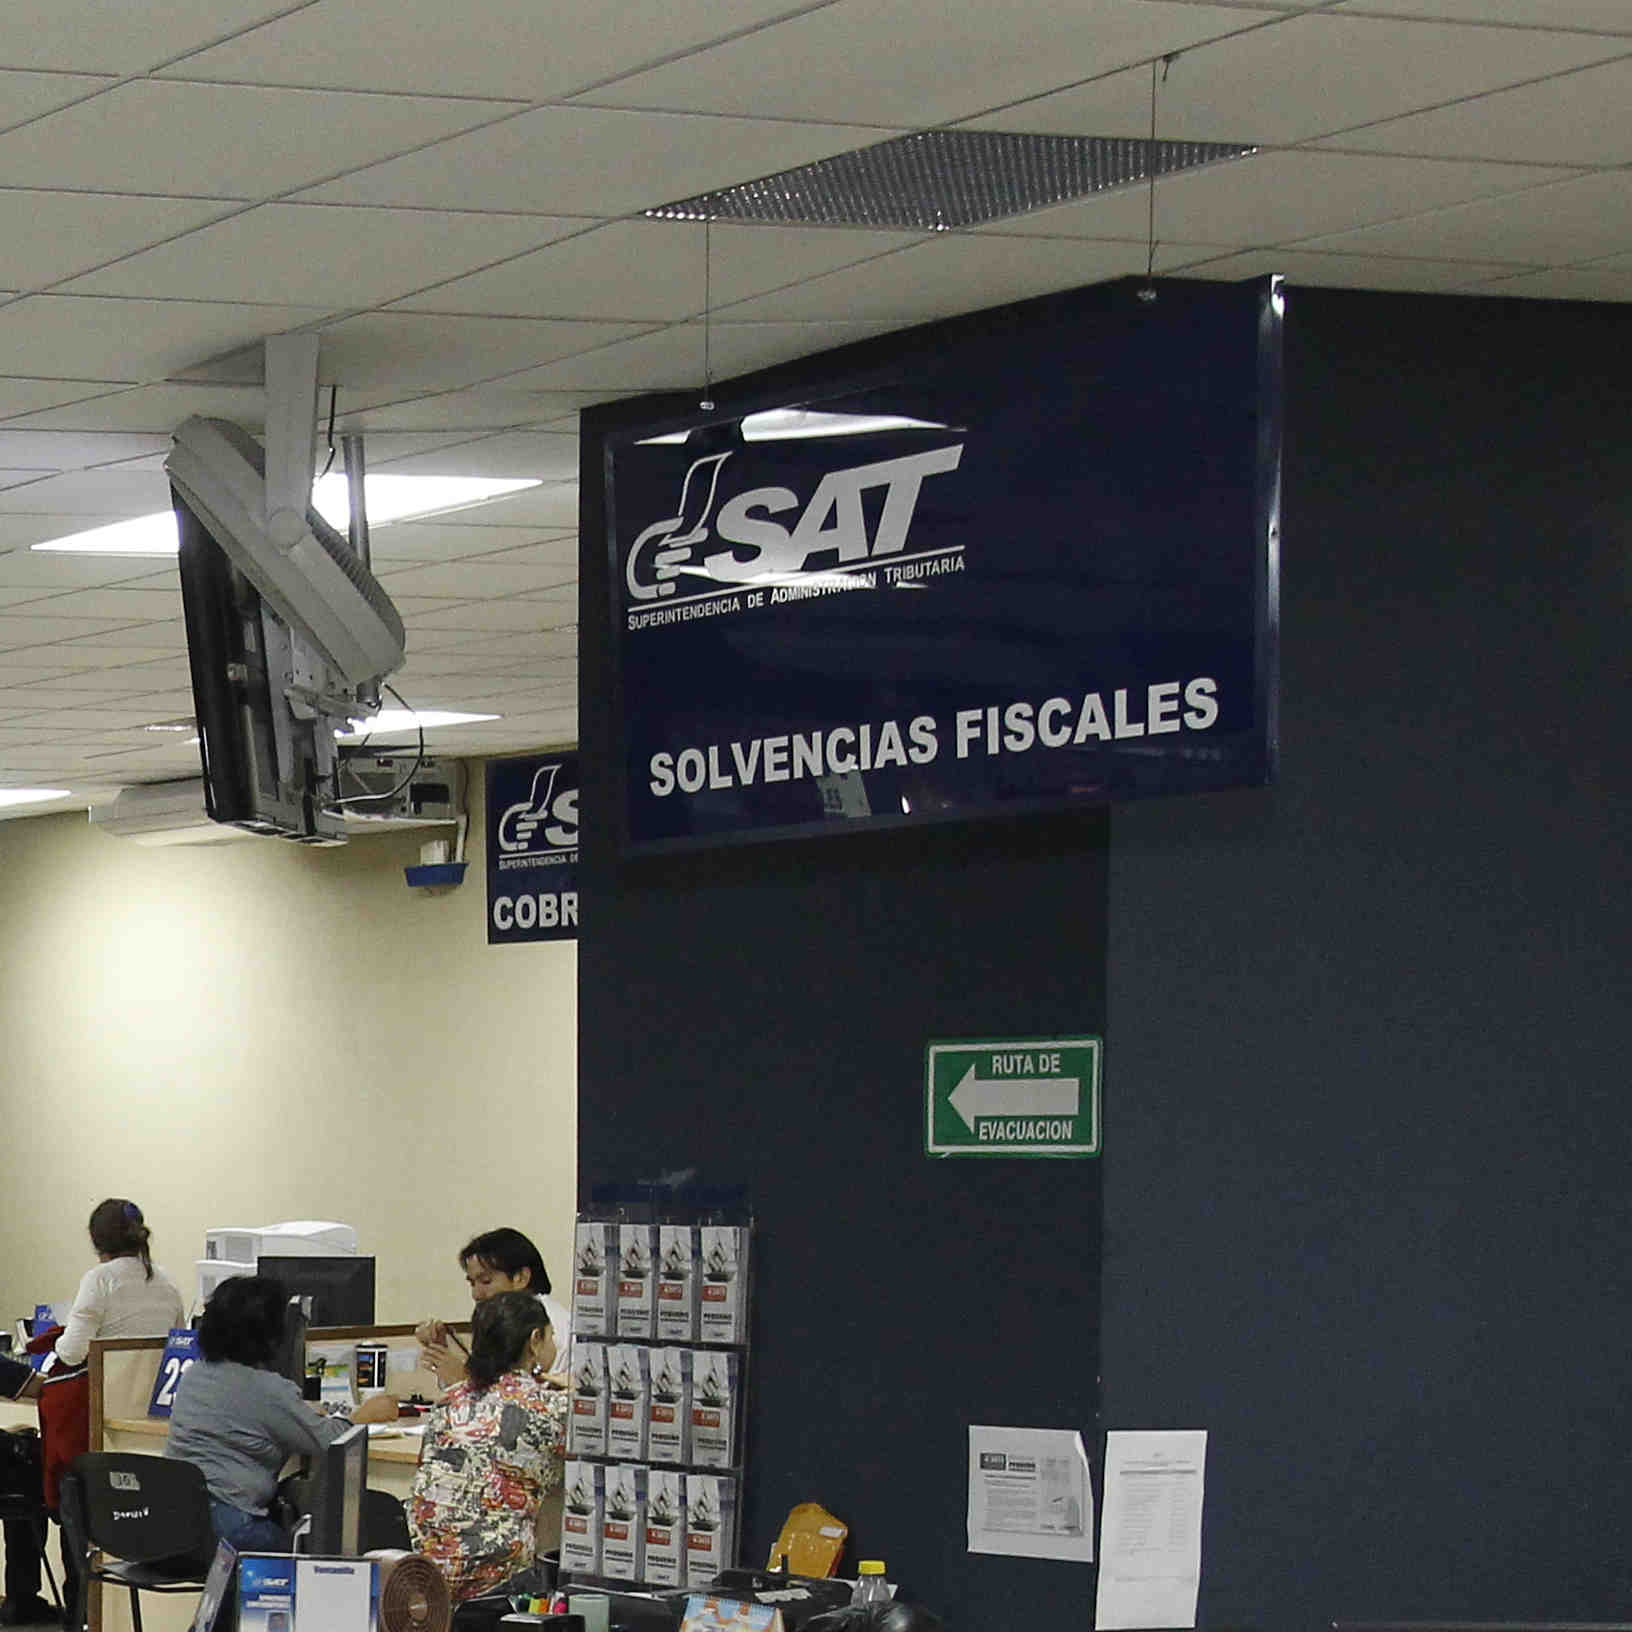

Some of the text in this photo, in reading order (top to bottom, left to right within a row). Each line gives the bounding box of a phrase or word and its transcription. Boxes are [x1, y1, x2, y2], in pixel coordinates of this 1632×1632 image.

[705, 444, 964, 581] SAT
[628, 599, 740, 631] SUPERINTENDENCIA
[747, 594, 765, 609] DE
[884, 555, 966, 583] TRIBUTARIA
[649, 677, 1219, 797] SOLVENCIAS FISCALES
[991, 1053, 1061, 1076] RUTA DE
[978, 1119, 1073, 1141] EVACUACION
